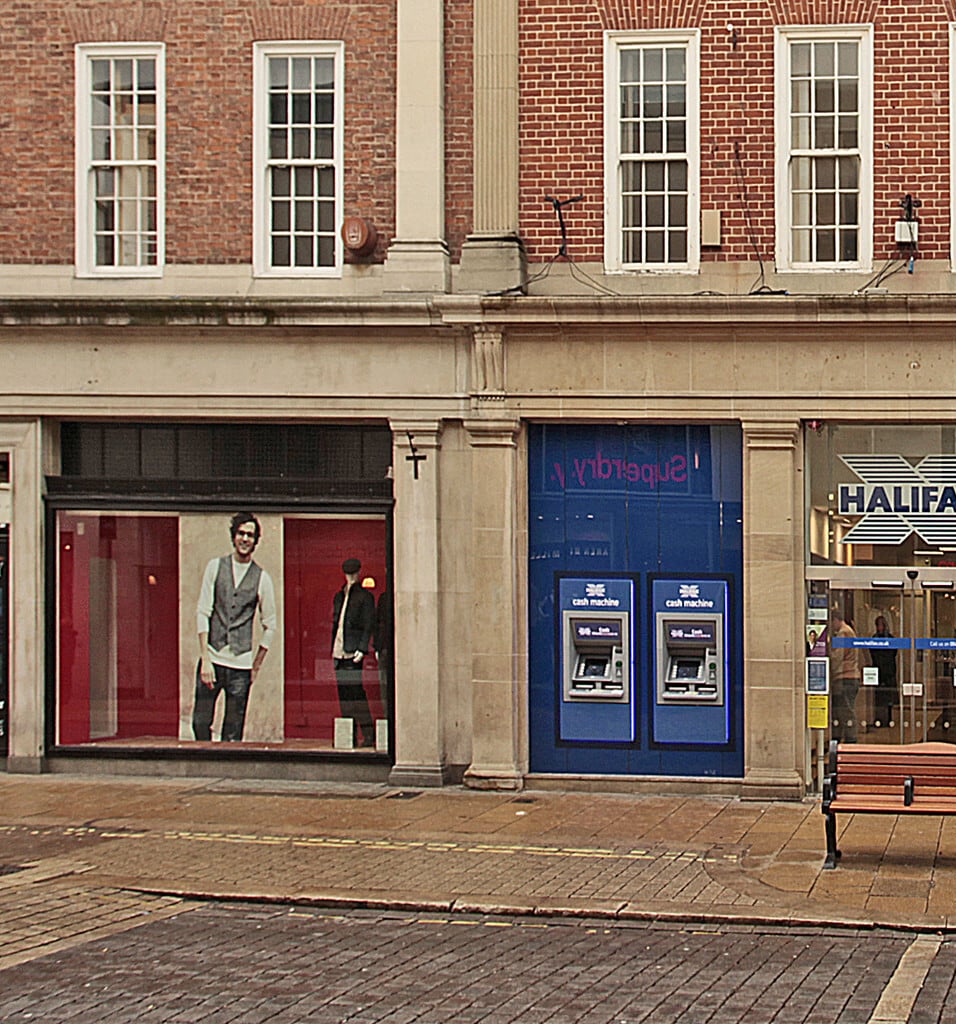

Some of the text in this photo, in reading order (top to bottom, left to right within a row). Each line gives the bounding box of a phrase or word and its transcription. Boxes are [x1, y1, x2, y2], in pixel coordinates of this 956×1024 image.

[572, 597, 620, 607] cash machine
[665, 598, 714, 609] cash machine
